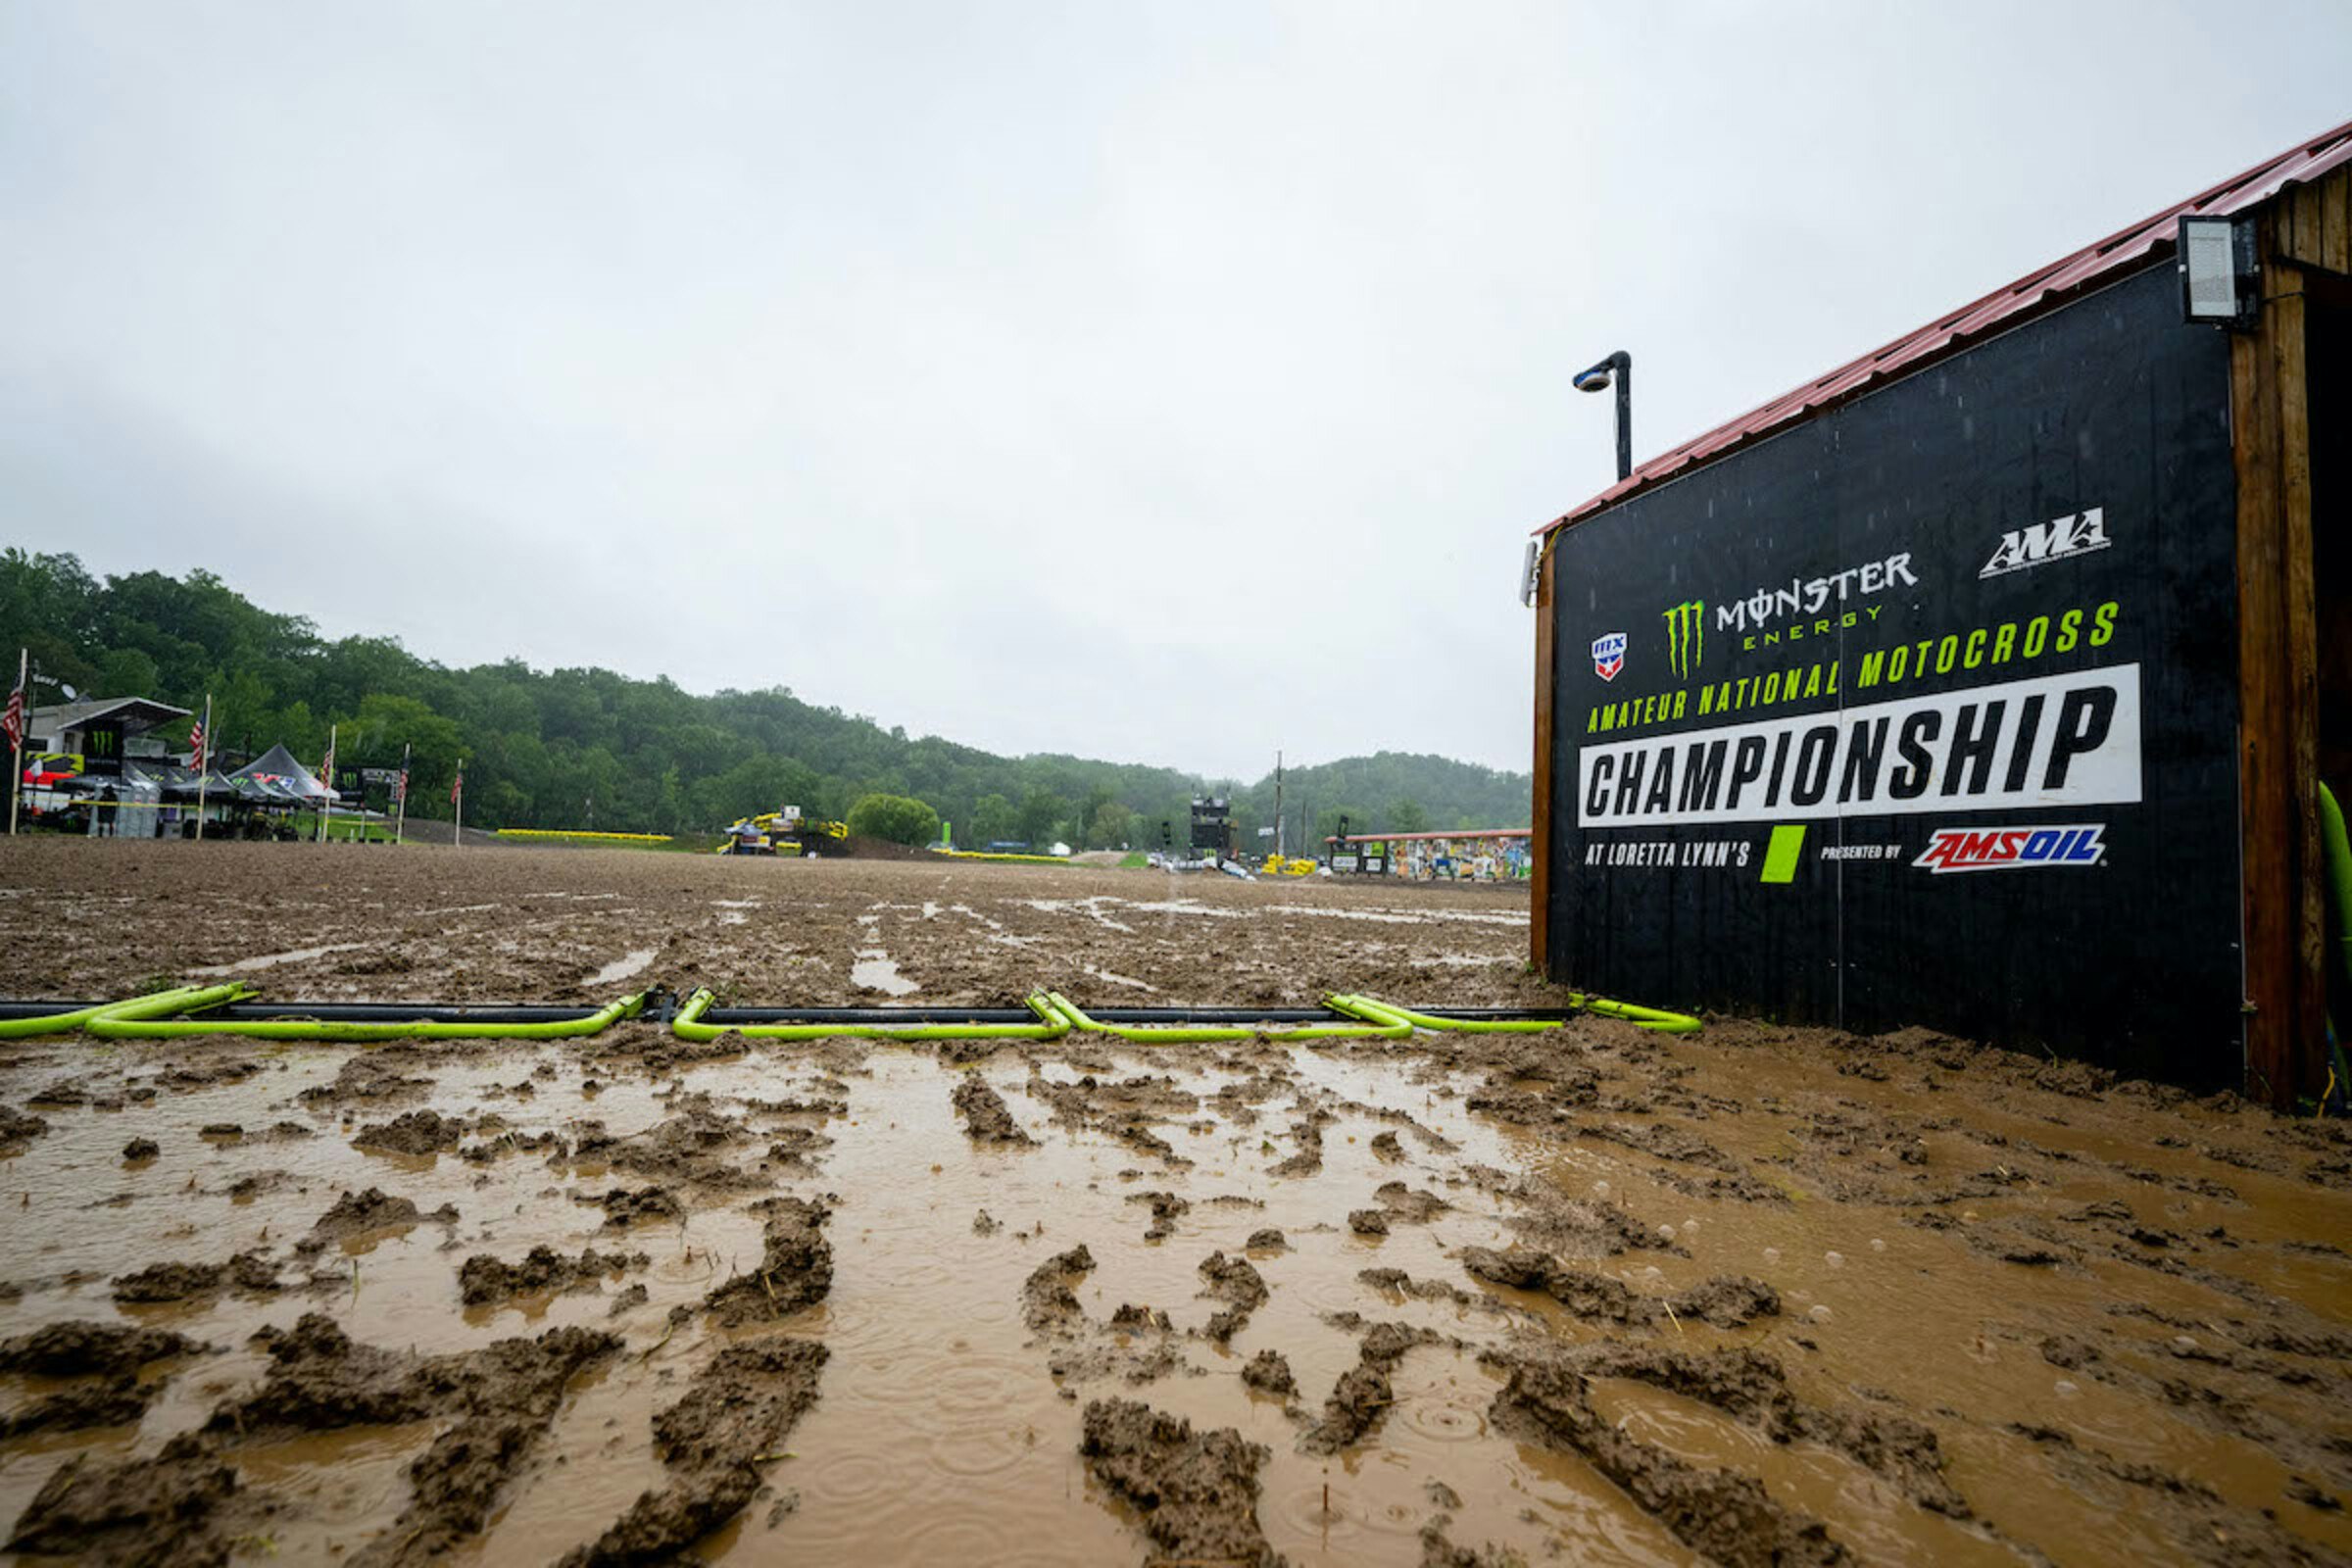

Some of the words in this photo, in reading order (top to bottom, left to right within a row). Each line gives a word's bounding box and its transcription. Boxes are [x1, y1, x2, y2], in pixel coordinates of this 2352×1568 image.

[1980, 507, 2110, 574] AMA
[1716, 553, 1918, 632] MONSTER
[1742, 605, 1883, 650] ENERGY
[1588, 691, 1687, 733] AMATEUR
[1697, 660, 1839, 714] NATIONAL
[1858, 601, 2119, 688] MOTOCROSS
[1585, 686, 2117, 817] CHAMPIONSHIP
[1585, 844, 1604, 866] AT
[1607, 843, 1675, 866] LORETTA
[1682, 842, 1751, 867] LYNN'S
[1820, 846, 1882, 859] PRESENTED
[1885, 845, 1902, 859] BY
[1922, 829, 2098, 869] AMSOIL
